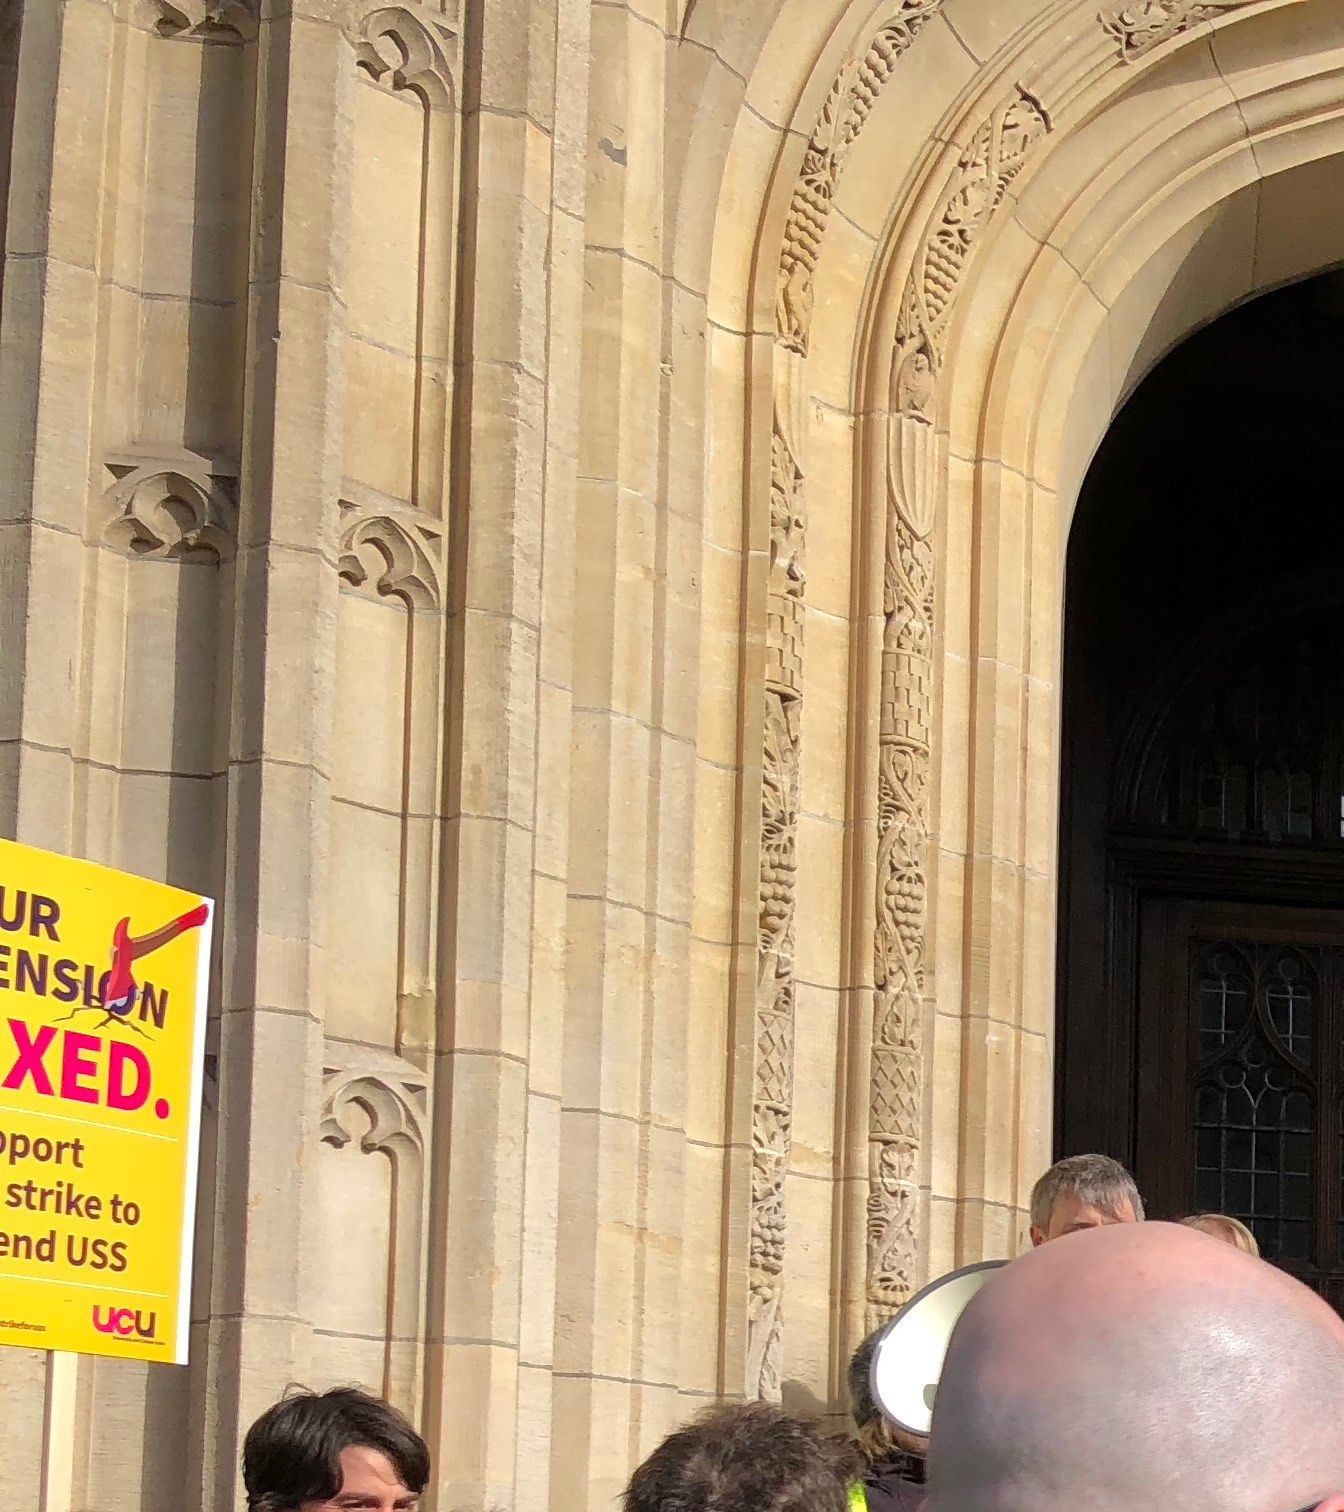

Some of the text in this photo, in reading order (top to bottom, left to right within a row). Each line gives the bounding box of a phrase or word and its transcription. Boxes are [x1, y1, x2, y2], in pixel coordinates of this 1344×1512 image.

[5, 1180, 140, 1226] strike to
[67, 1234, 128, 1273] USS
